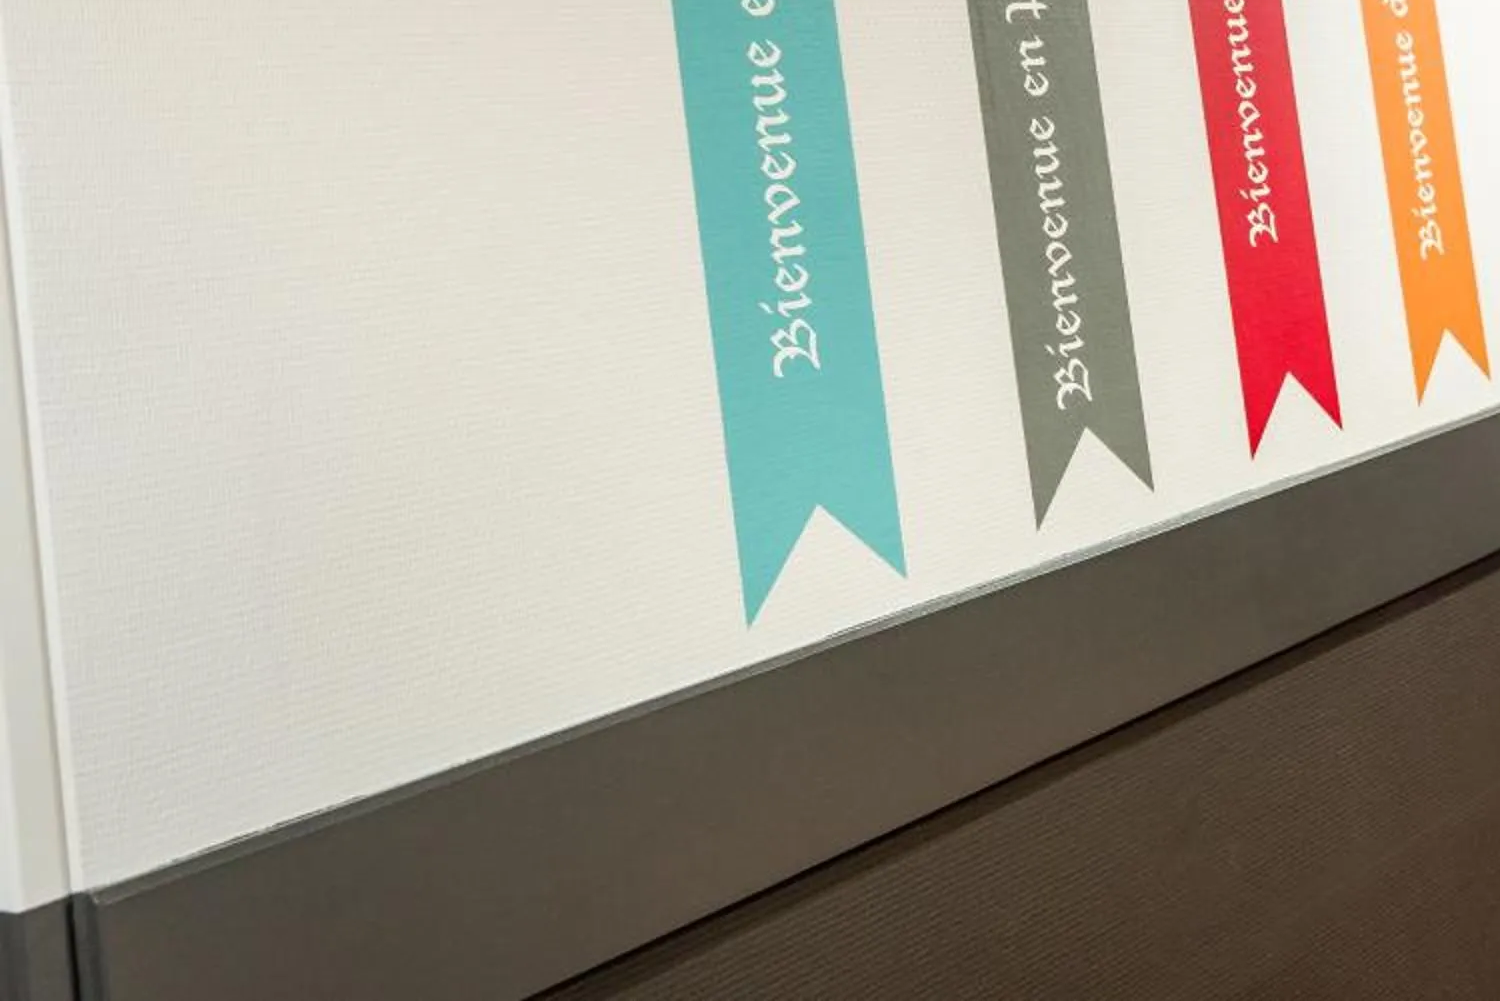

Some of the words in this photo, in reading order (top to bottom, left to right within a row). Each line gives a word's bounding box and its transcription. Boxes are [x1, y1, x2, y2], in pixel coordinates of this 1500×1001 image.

[1019, 34, 1050, 97] en
[1395, 31, 1444, 261] Bienvenue
[746, 39, 821, 378] Bienvenue
[1030, 116, 1093, 410] Bienvenue
